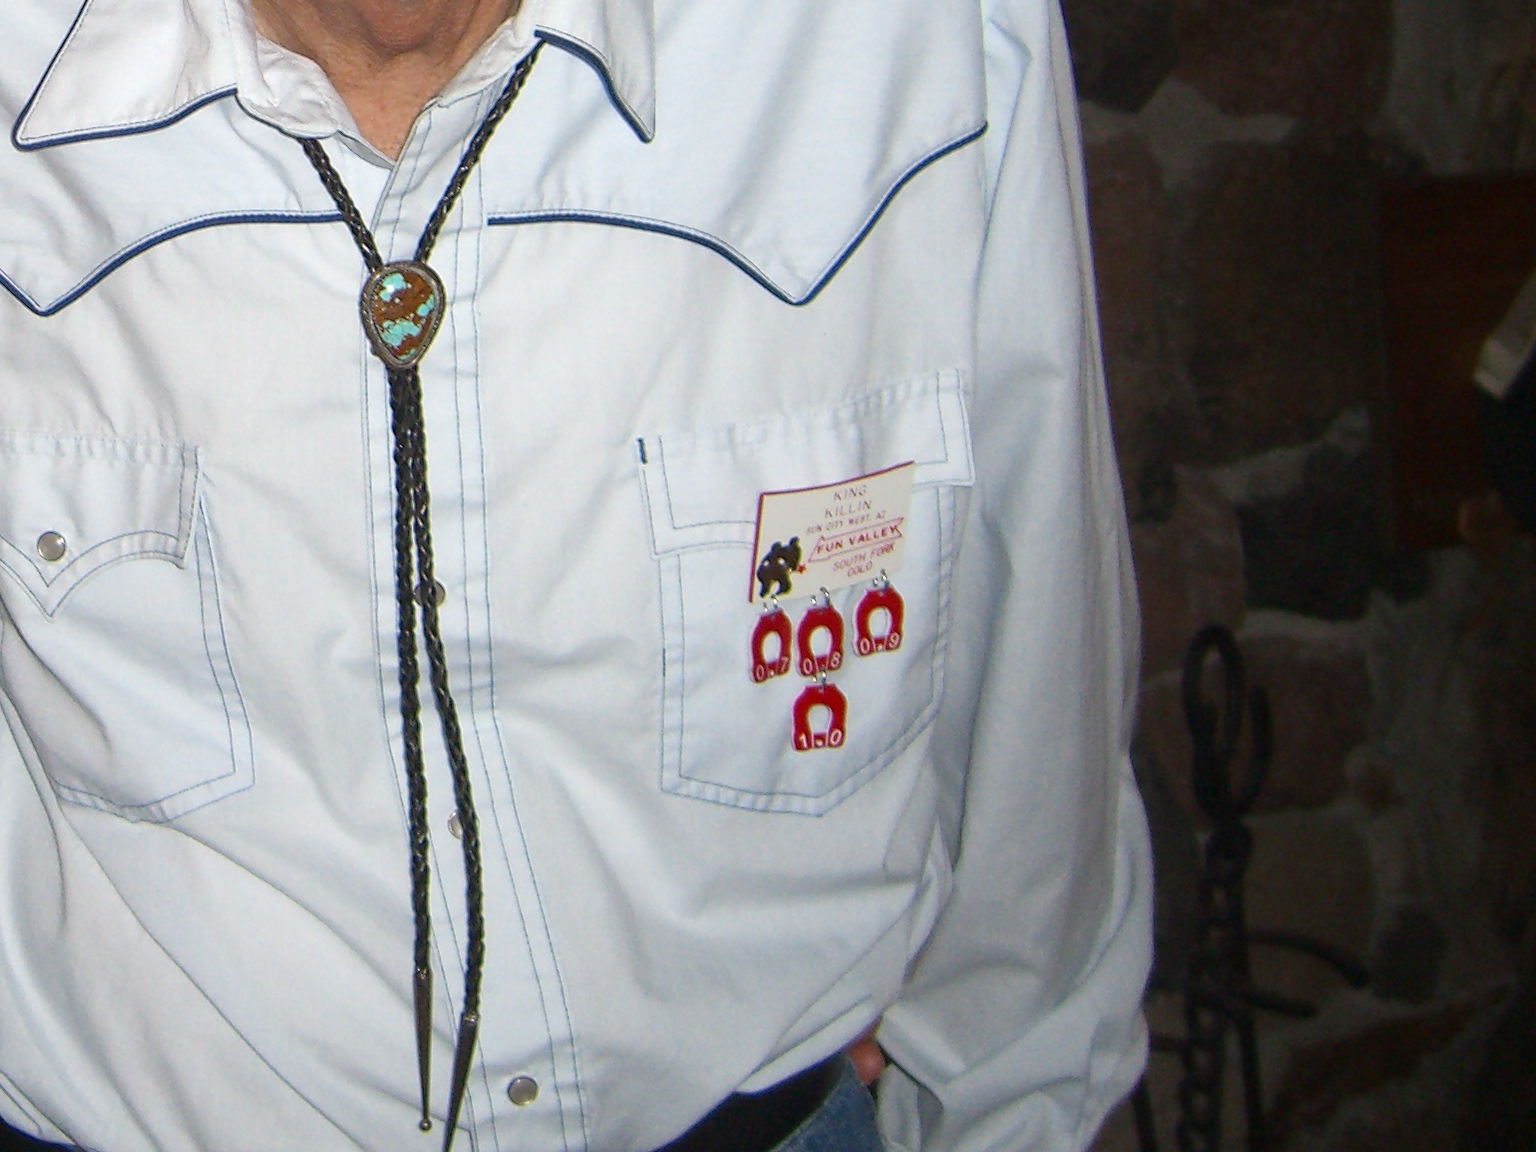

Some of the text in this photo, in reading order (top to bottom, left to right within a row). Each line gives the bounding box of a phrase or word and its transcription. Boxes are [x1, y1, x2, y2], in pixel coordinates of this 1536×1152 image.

[834, 485, 867, 501] KING
[825, 499, 872, 518] KILLIN
[817, 525, 898, 554] FUN VALLEY
[833, 552, 866, 571] SOUTH
